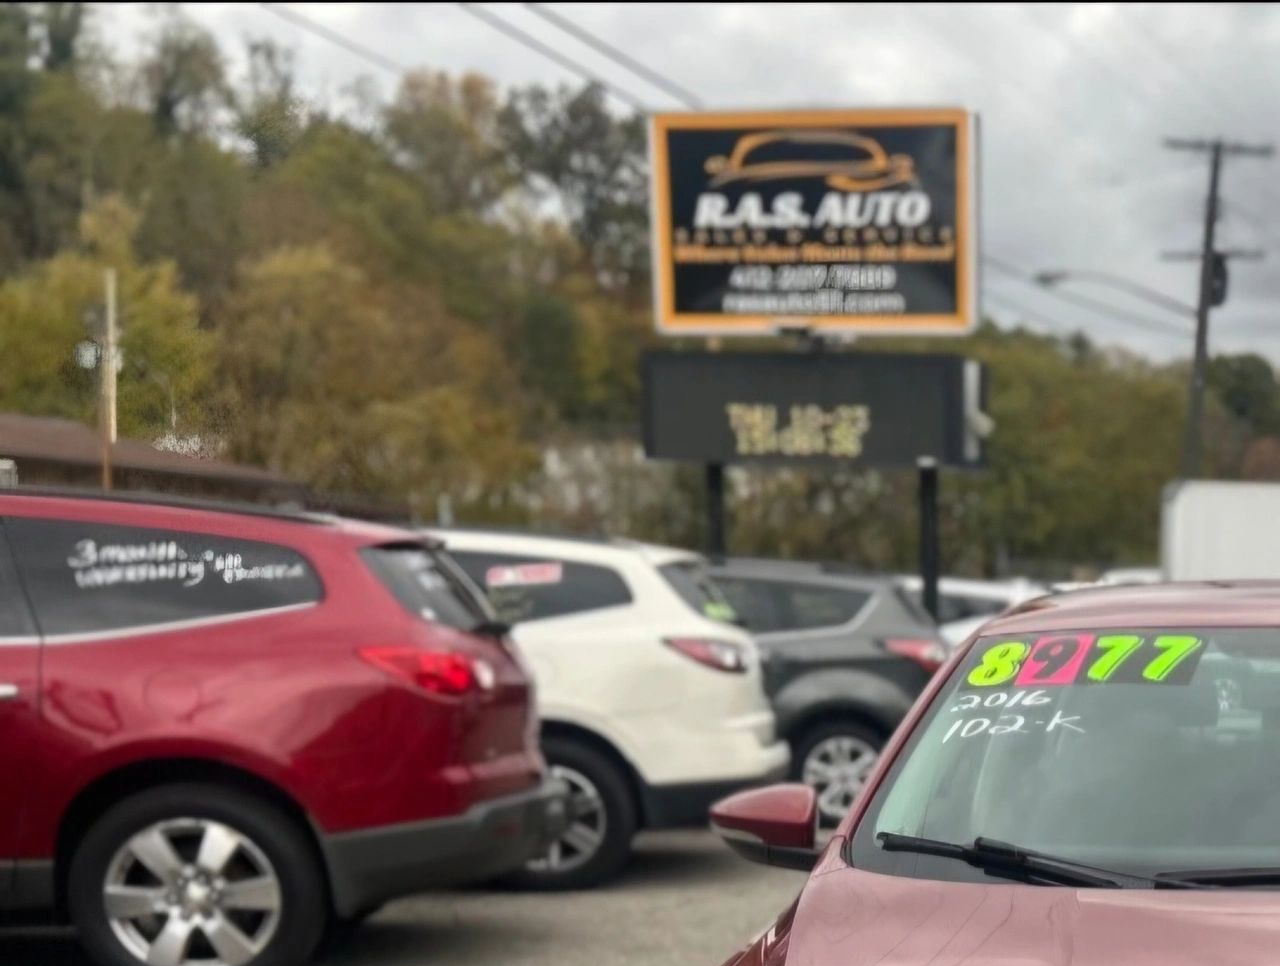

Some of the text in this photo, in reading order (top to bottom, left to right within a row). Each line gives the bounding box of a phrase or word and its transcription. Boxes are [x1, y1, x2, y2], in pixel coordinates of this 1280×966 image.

[694, 190, 931, 228] R.A.S. AUTO
[966, 634, 1203, 687] 8977
[949, 690, 1052, 713] 2016
